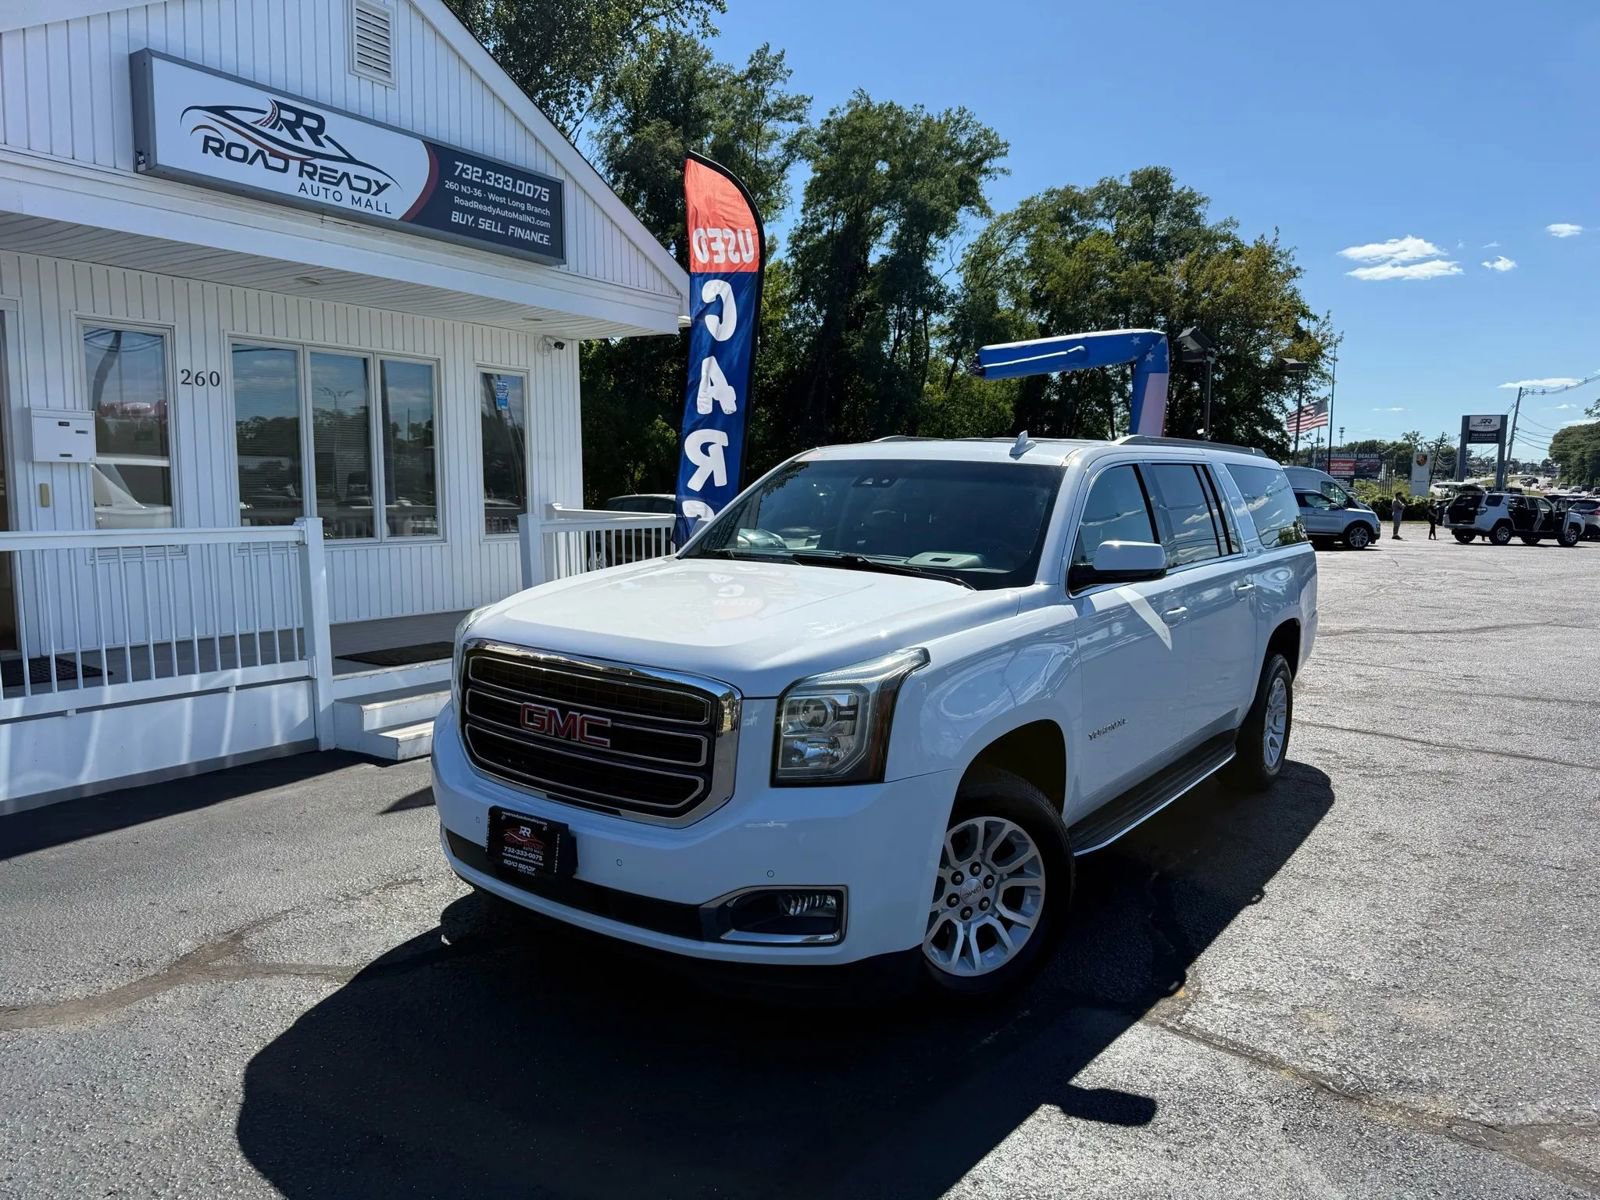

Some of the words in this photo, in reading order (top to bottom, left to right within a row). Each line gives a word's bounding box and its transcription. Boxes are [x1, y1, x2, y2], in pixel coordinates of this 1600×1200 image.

[269, 98, 326, 148] RR
[201, 134, 290, 174] ROAD
[298, 160, 391, 197] READY
[454, 161, 550, 202] 732.333.0075
[298, 181, 343, 202] AUTO
[351, 194, 392, 215] MALL
[444, 180, 459, 191] 260
[461, 184, 483, 197] NJ-36
[488, 191, 507, 204] West
[508, 197, 526, 211] Long
[526, 203, 551, 217] Branch
[454, 195, 551, 229] RoadReadyAutoMallNJ.com
[451, 210, 475, 227] BUY.
[478, 217, 506, 235] SELL.
[508, 225, 552, 246] FINANCE.
[180, 368, 221, 388] 260
[520, 701, 612, 748] GMC
[518, 825, 532, 838] RR
